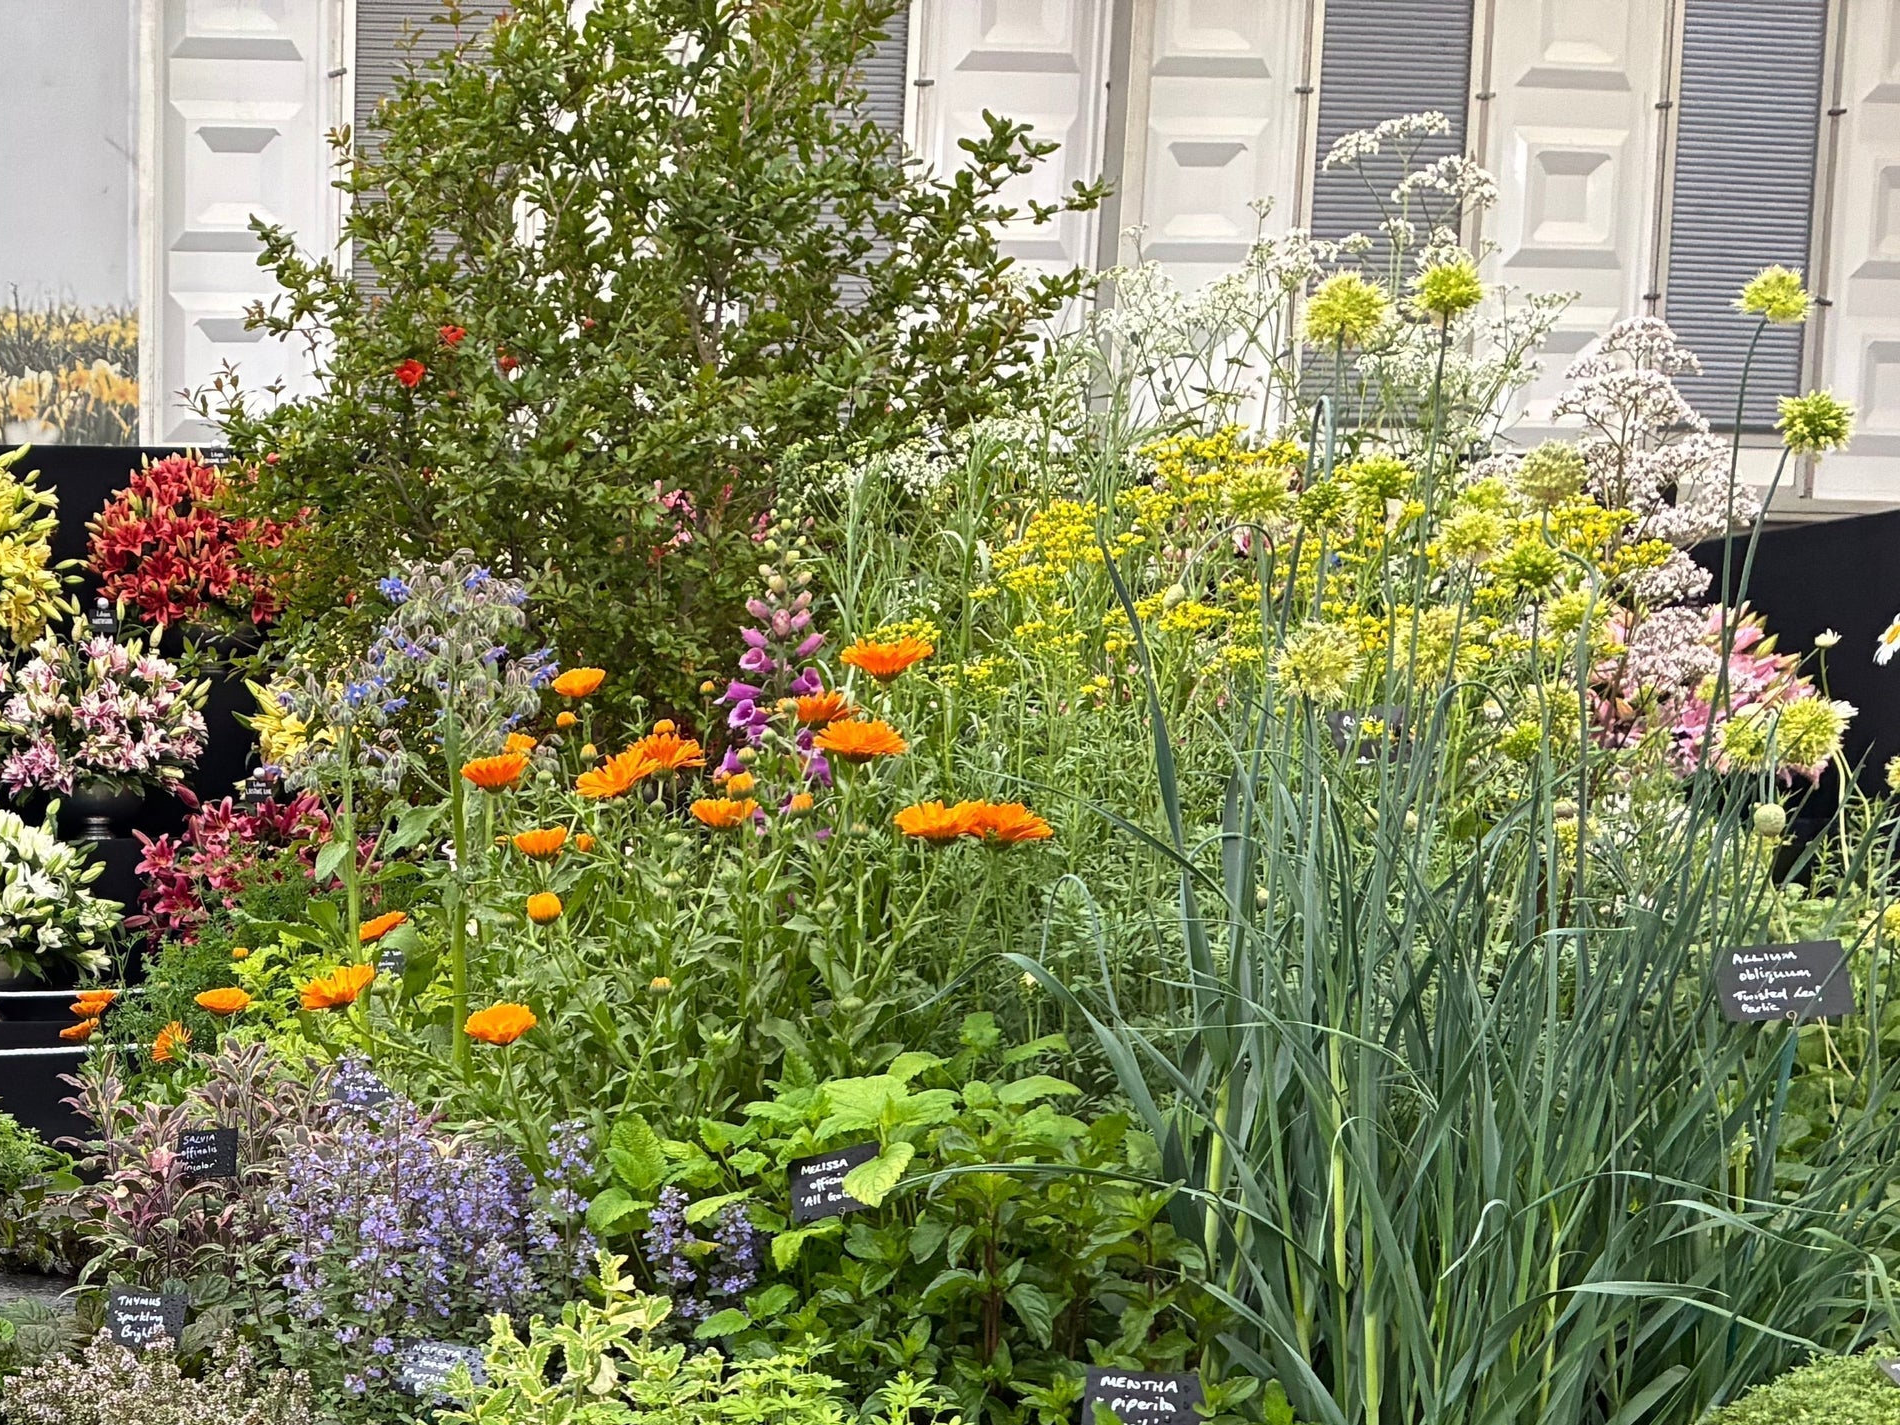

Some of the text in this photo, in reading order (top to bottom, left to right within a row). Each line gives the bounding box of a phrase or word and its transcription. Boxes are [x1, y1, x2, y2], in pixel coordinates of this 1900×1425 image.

[183, 1134, 215, 1145] SALVIA
[801, 1159, 848, 1175] MELISSA
[117, 1295, 161, 1307] THYMUS
[412, 1344, 462, 1360] NEPETA
[1100, 1376, 1178, 1394] MENTHA
